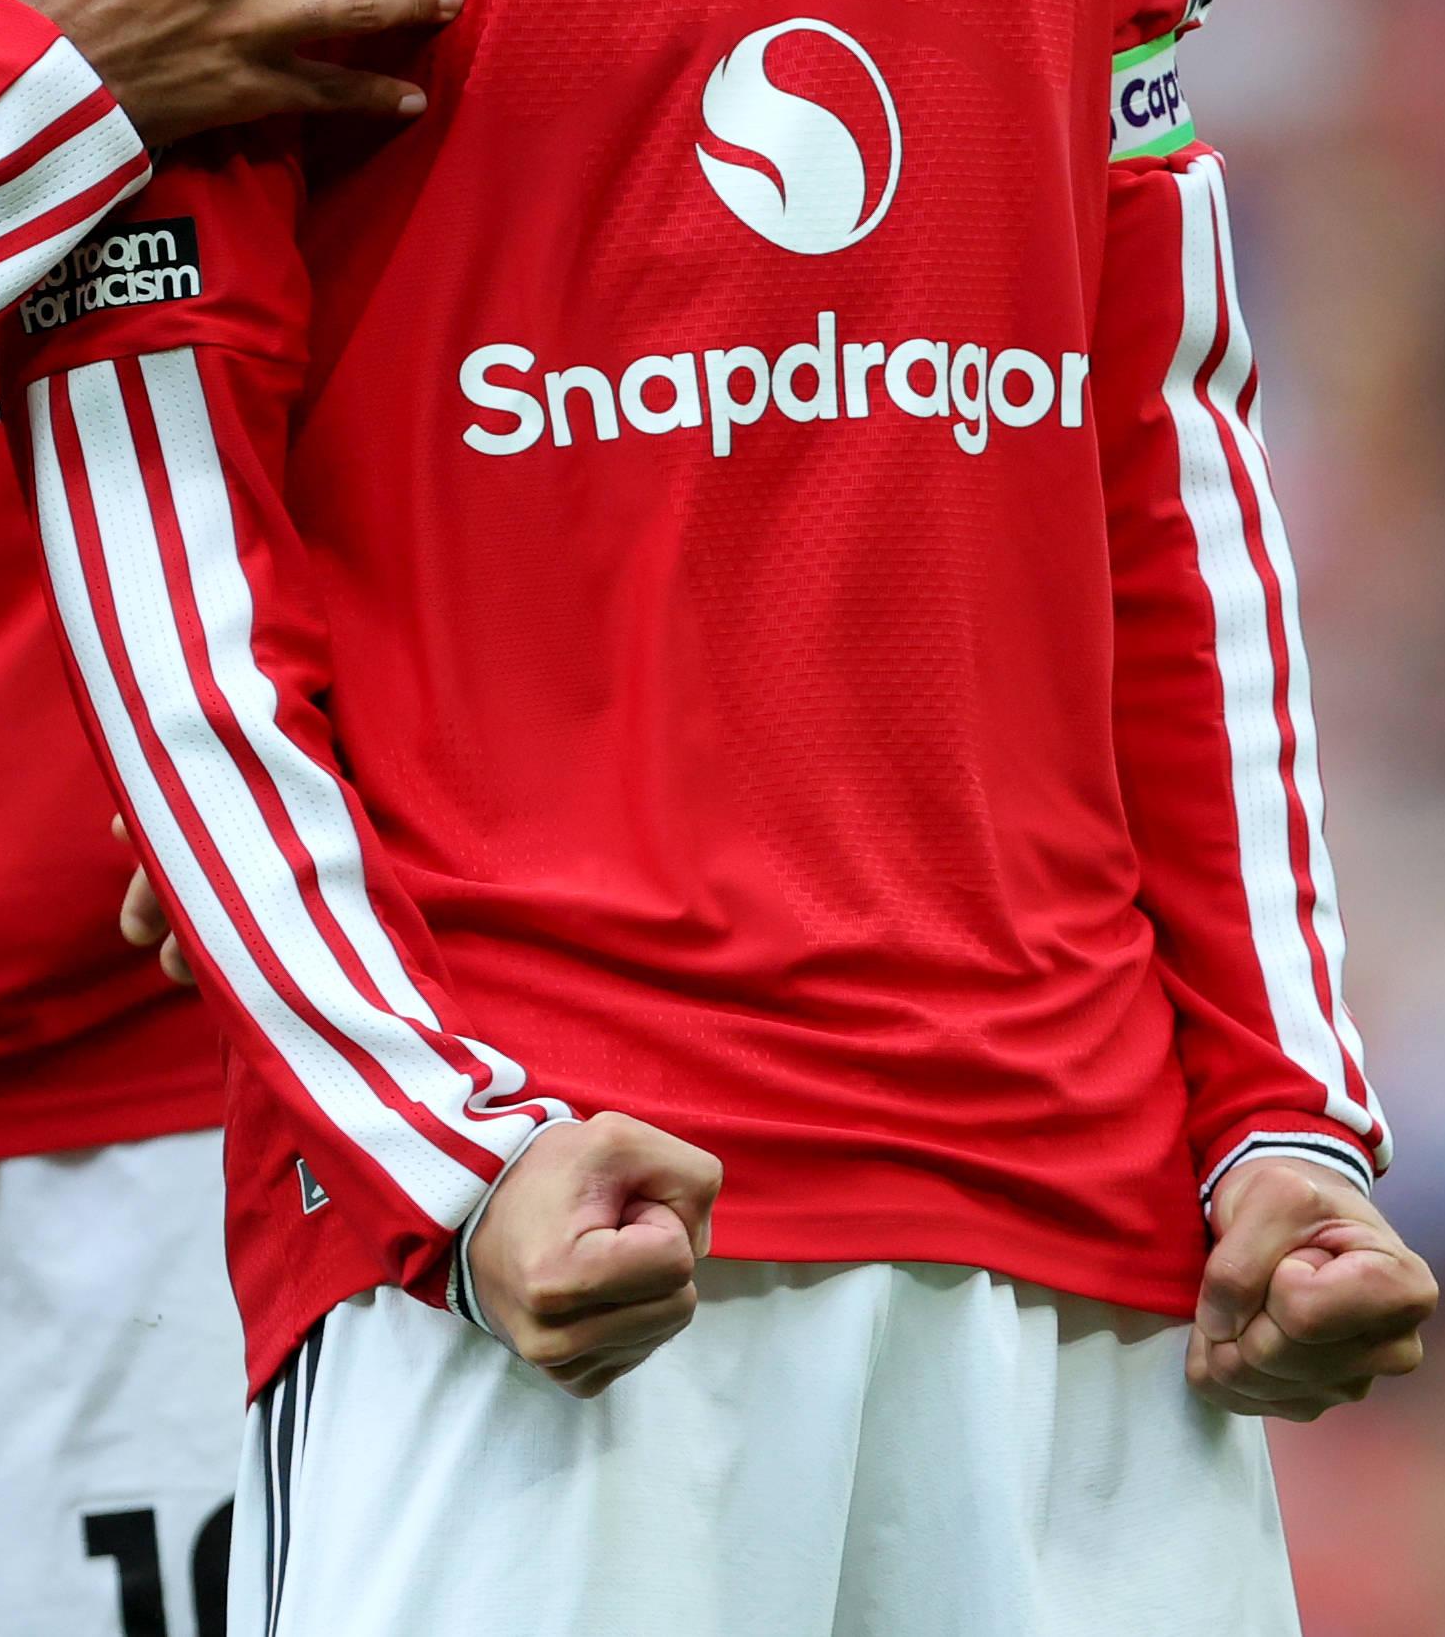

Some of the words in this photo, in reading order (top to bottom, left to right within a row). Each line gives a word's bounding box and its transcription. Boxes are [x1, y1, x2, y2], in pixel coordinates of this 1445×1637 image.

[1120, 66, 1185, 128] Cap
[37, 257, 68, 292] o
[71, 230, 178, 280] room
[19, 290, 71, 334] for
[75, 264, 201, 317] racism
